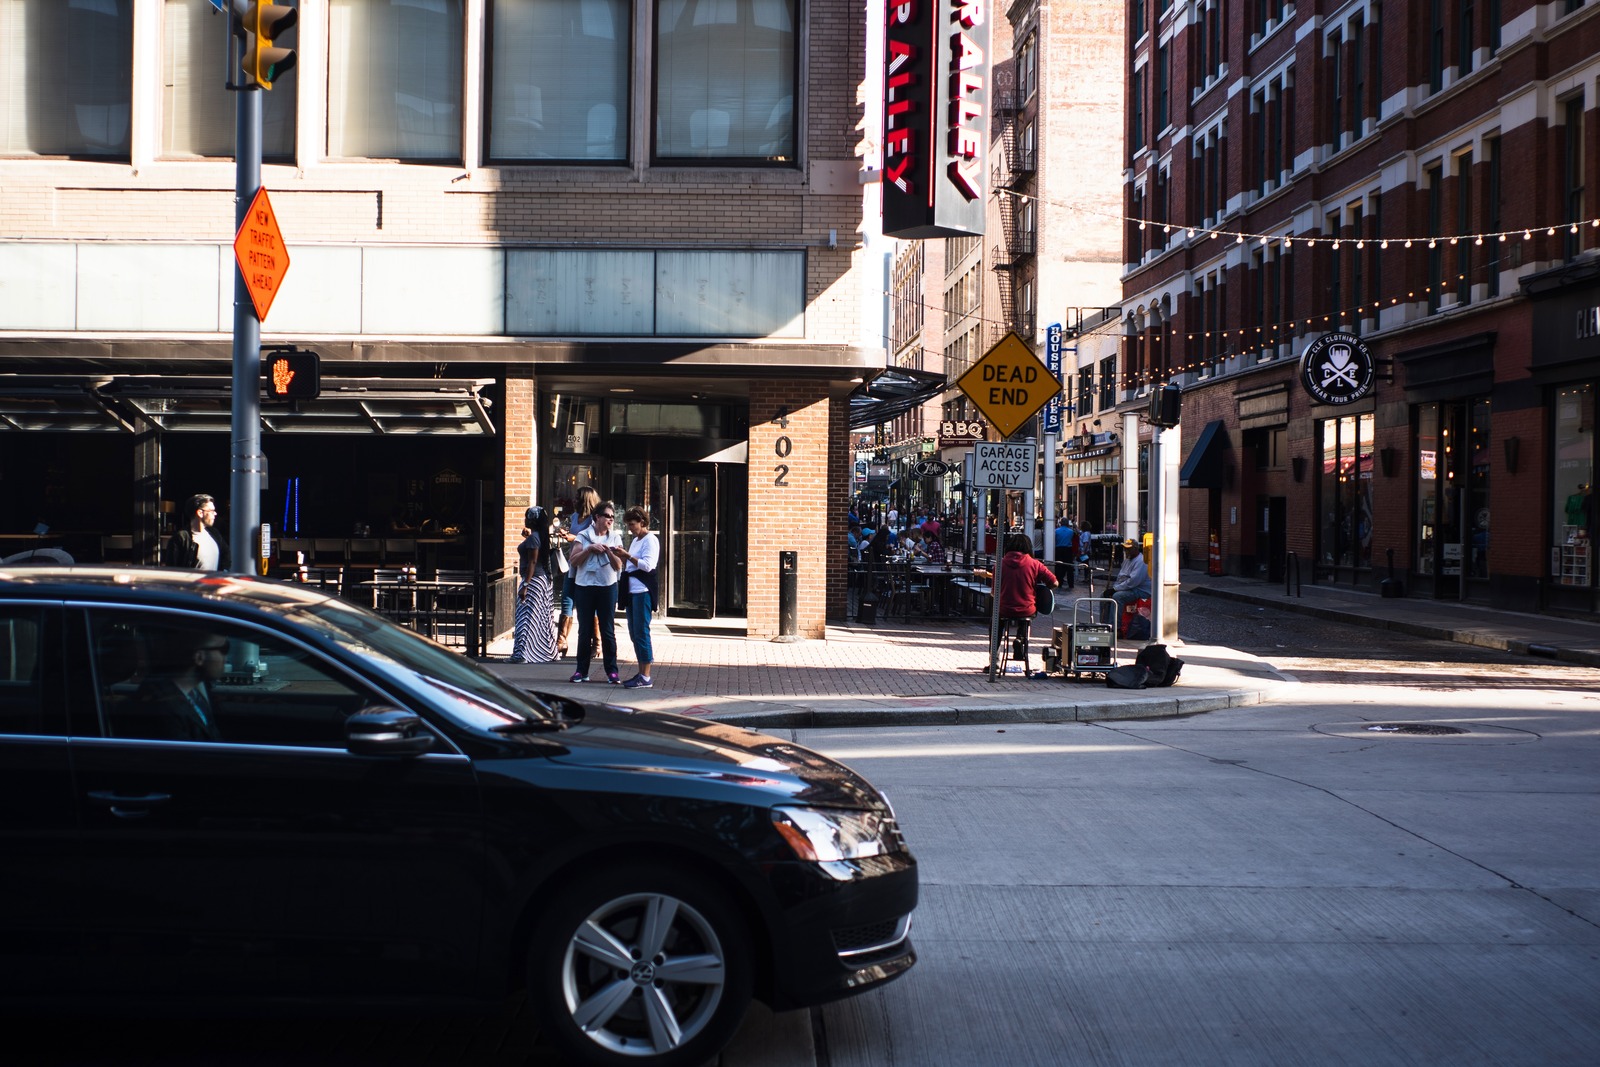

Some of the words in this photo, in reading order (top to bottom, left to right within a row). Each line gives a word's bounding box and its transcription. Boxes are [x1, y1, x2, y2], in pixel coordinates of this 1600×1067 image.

[887, 39, 914, 194] ALLEY
[954, 32, 984, 200] ALLEY
[255, 210, 269, 226] NEW
[250, 229, 275, 250] TRAFFIC
[248, 250, 275, 271] PATTERN
[252, 274, 273, 291] AHEAD
[1050, 326, 1060, 371] HOUSE
[1311, 341, 1324, 354] CLE
[1325, 334, 1358, 345] CLOTHING
[1358, 343, 1368, 355] CO.
[982, 364, 1038, 384] DEAD
[988, 387, 1029, 406] END
[1311, 384, 1327, 399] WEAR
[1351, 385, 1368, 400] PRIDE
[568, 435, 581, 443] 402
[942, 422, 983, 439] BBQ
[771, 406, 792, 486] 402
[980, 446, 1030, 460] GARAGE
[981, 459, 1030, 473] ACCESS
[988, 472, 1020, 486] ONLY
